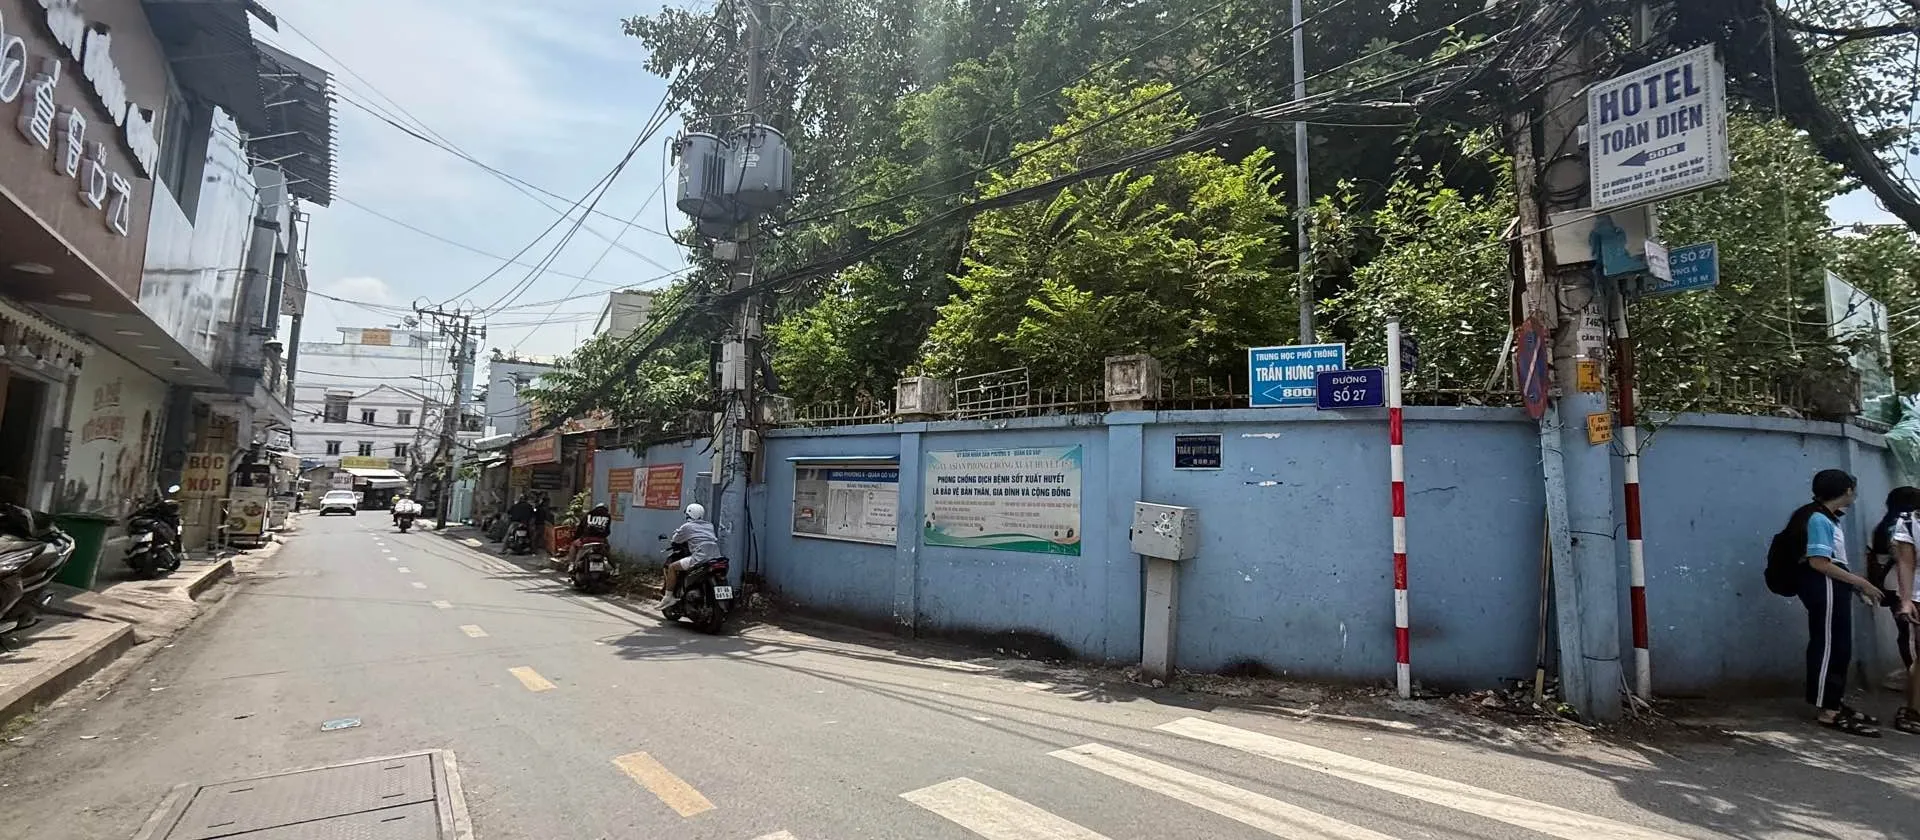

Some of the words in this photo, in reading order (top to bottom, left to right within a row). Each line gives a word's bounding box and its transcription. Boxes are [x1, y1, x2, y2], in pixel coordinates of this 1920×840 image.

[1600, 63, 1701, 125] HOTEL
[1601, 121, 1650, 155] TOÀN
[1657, 104, 1703, 138] DIỆN
[1649, 145, 1679, 161] 50M
[1699, 248, 1712, 259] 27
[1256, 352, 1279, 361] TRUNG
[1280, 351, 1295, 361] HỌC
[1313, 348, 1338, 358] THÔNG
[1285, 364, 1314, 381] HƯNG
[1332, 375, 1367, 384] ĐƯỜNG
[1283, 388, 1316, 397] 800
[1333, 385, 1350, 401] SỐ
[1353, 389, 1366, 401] 27
[957, 473, 976, 483] CHỐNG
[978, 475, 991, 485] DỊCH
[1011, 473, 1023, 483] SỐT
[1044, 473, 1064, 483] HUYẾT
[992, 487, 1003, 496] GIA
[1004, 486, 1020, 496] ĐÌNH
[1021, 486, 1030, 496] VÀ
[1031, 487, 1049, 498] CỘNG
[587, 514, 609, 526] LOVE
